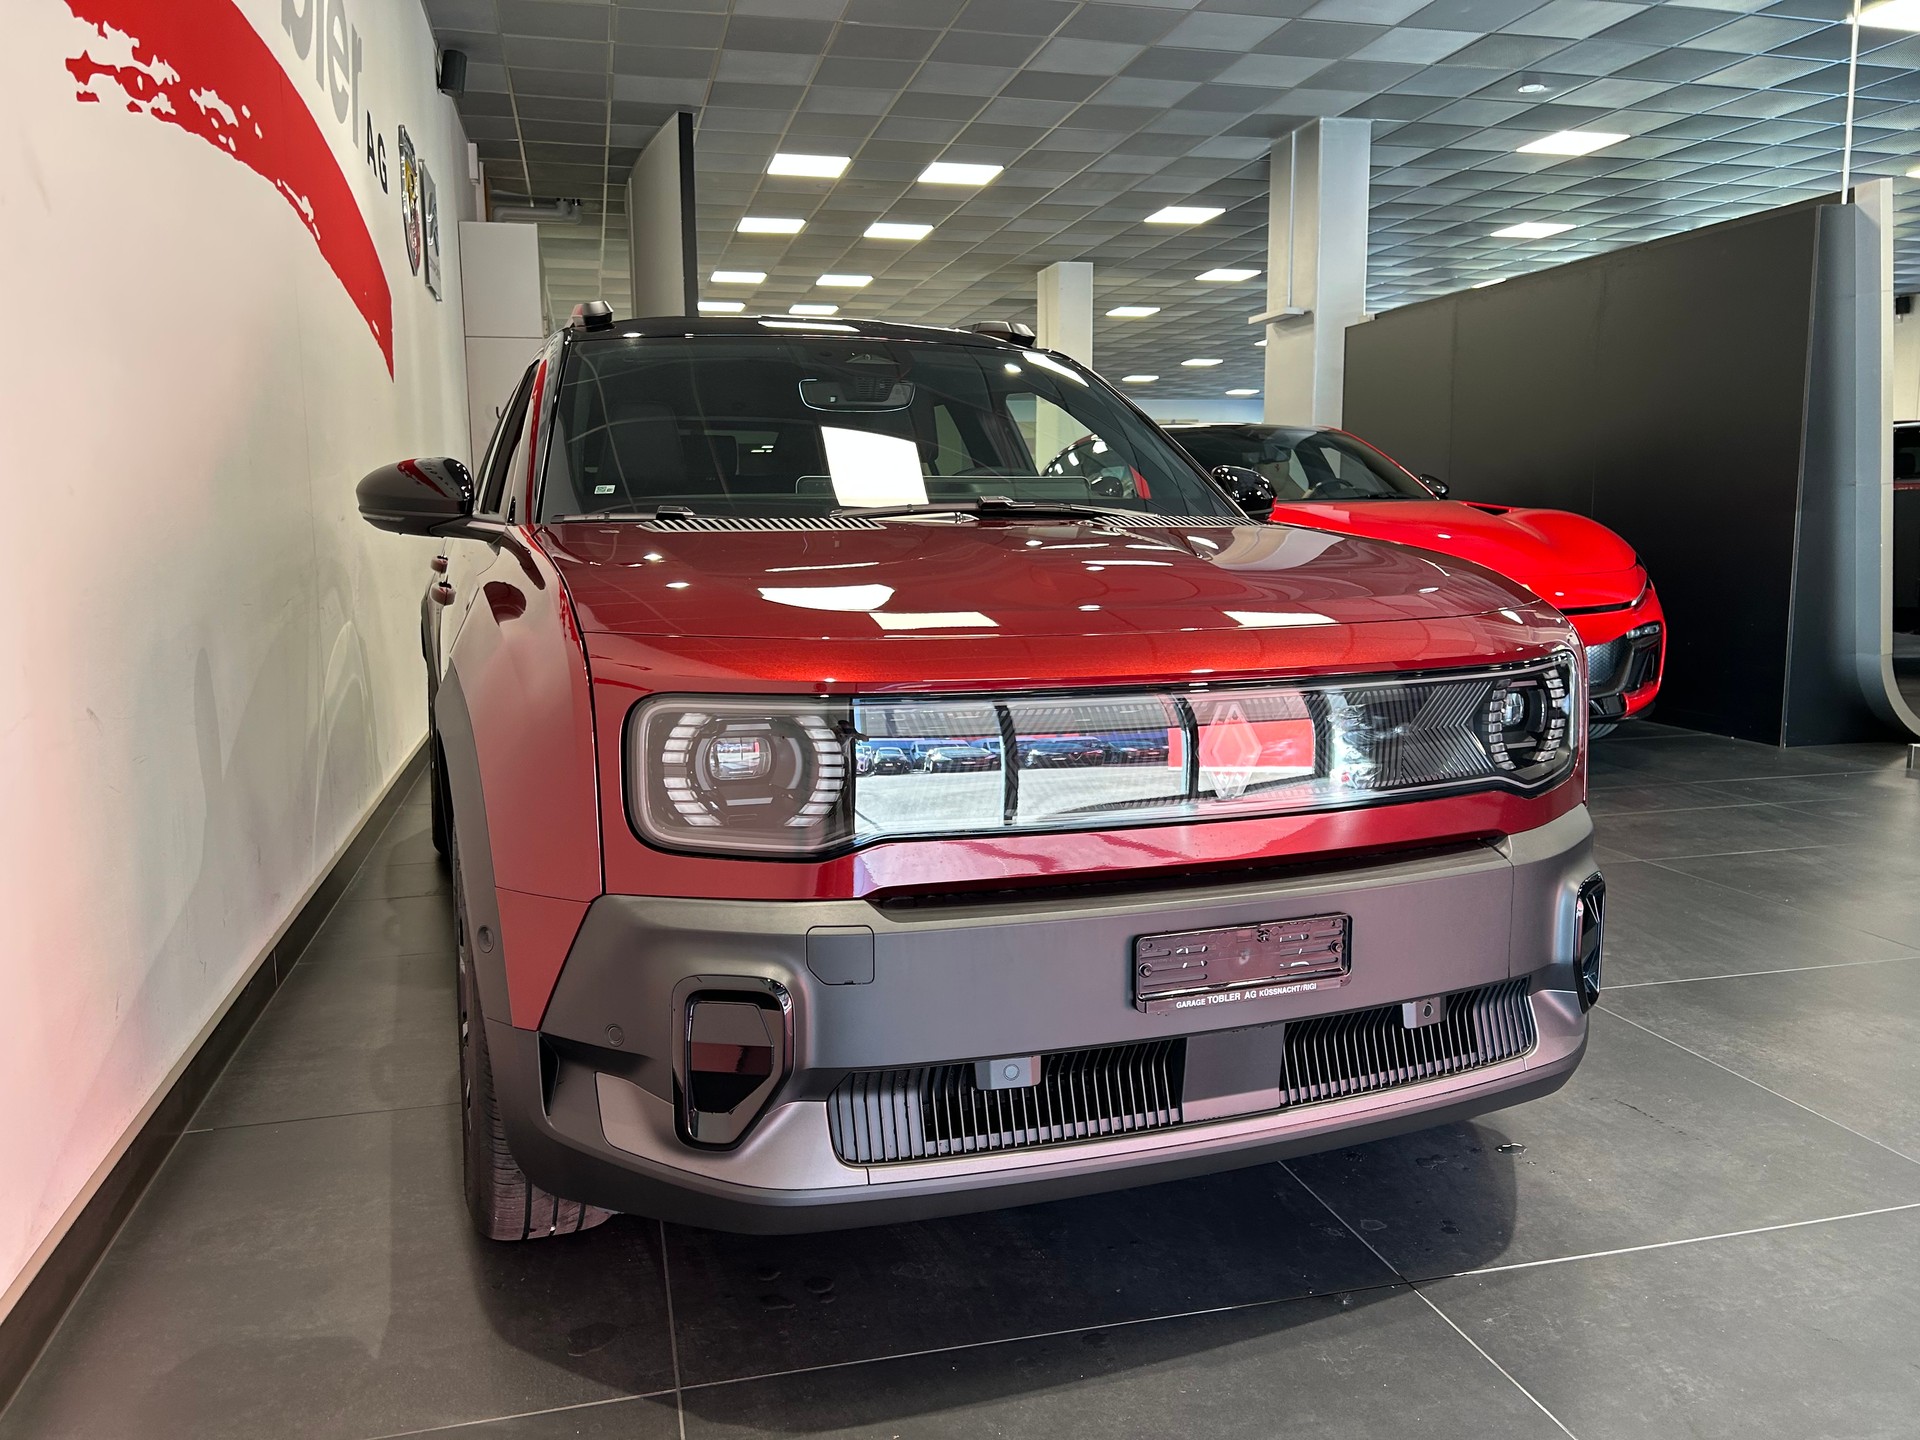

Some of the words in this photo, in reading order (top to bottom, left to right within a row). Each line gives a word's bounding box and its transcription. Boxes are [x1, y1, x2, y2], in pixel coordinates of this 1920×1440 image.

[366, 109, 388, 194] AG
[1176, 998, 1206, 1008] GARAGE
[1207, 992, 1241, 1004] TOBLER
[1244, 990, 1257, 999] AG
